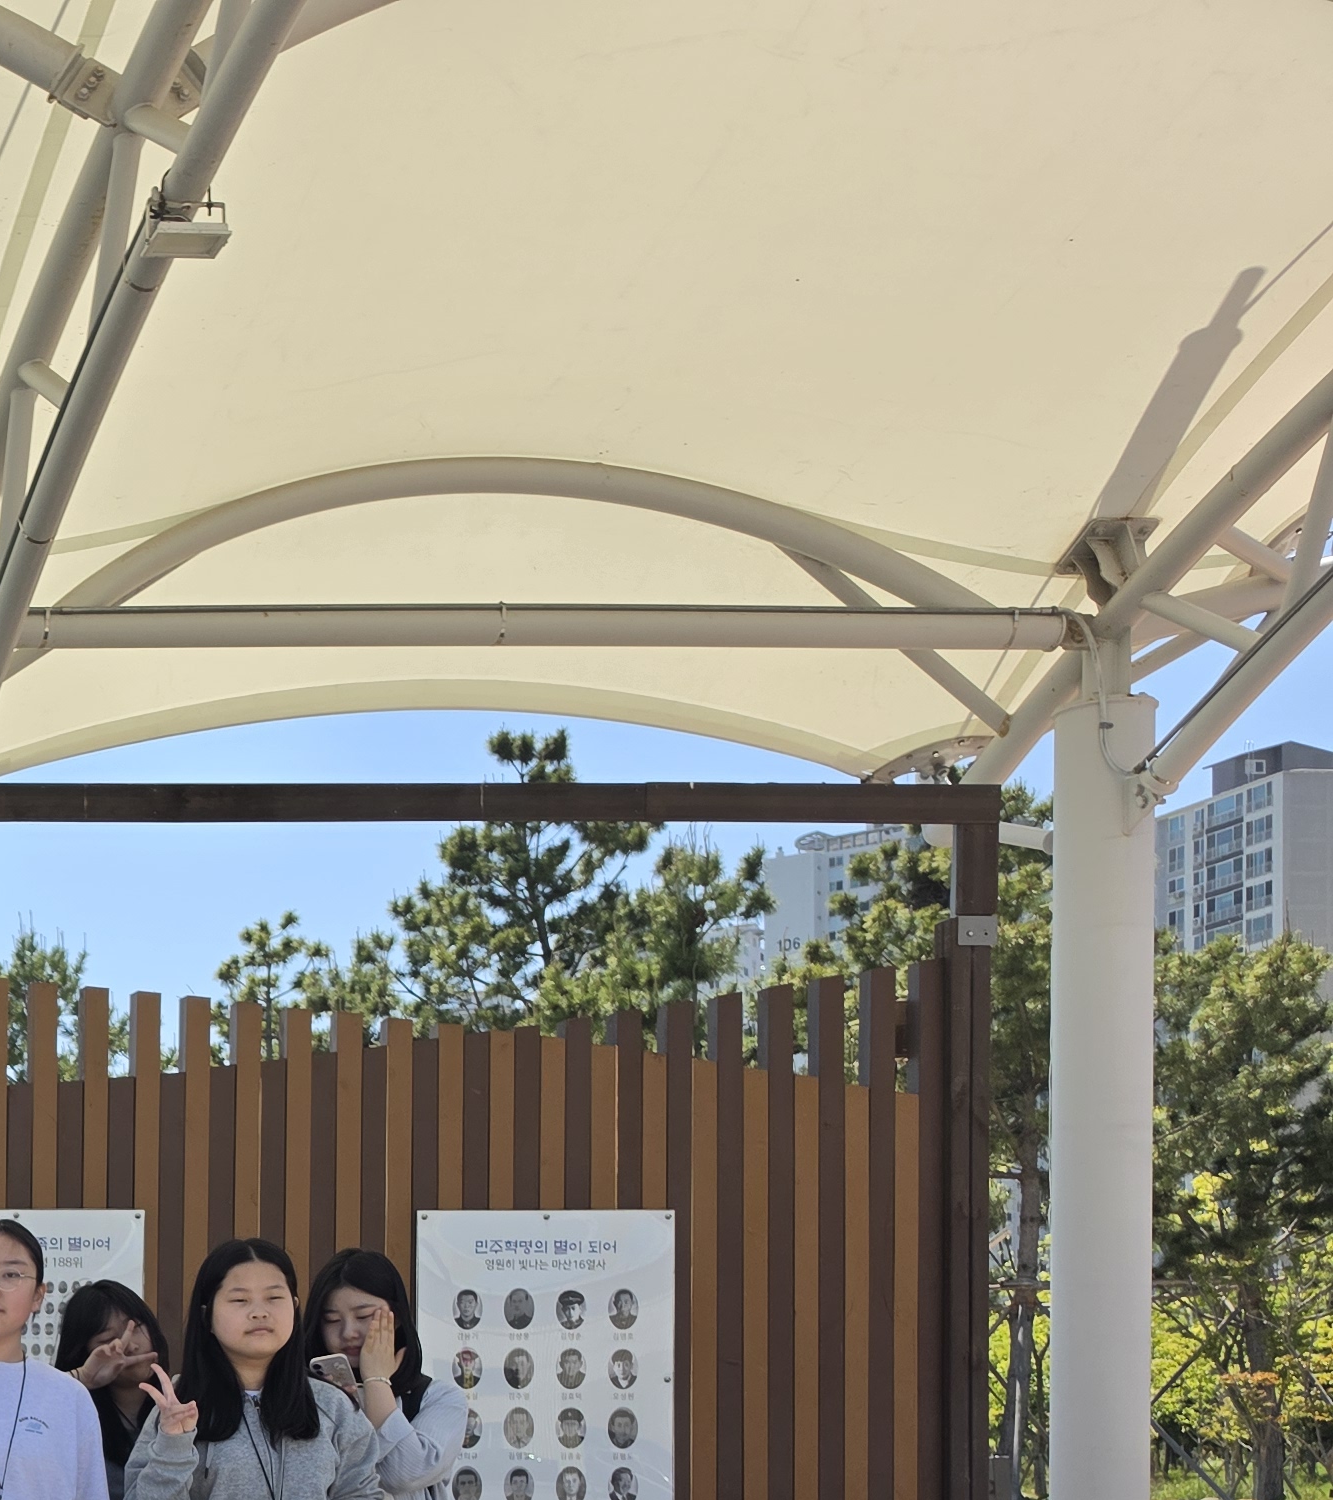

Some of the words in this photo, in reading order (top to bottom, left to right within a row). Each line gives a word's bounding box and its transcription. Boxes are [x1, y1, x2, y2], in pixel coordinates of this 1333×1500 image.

[777, 937, 801, 952] 106
[68, 1237, 110, 1252] 별이여
[475, 1239, 548, 1255] 민주혁명의
[554, 1239, 582, 1255] 별이
[588, 1239, 617, 1254] 되어
[53, 1256, 83, 1268] 188위
[485, 1259, 515, 1271] 영원히
[519, 1259, 549, 1271] 빛나는
[552, 1259, 606, 1271] 마산16열사
